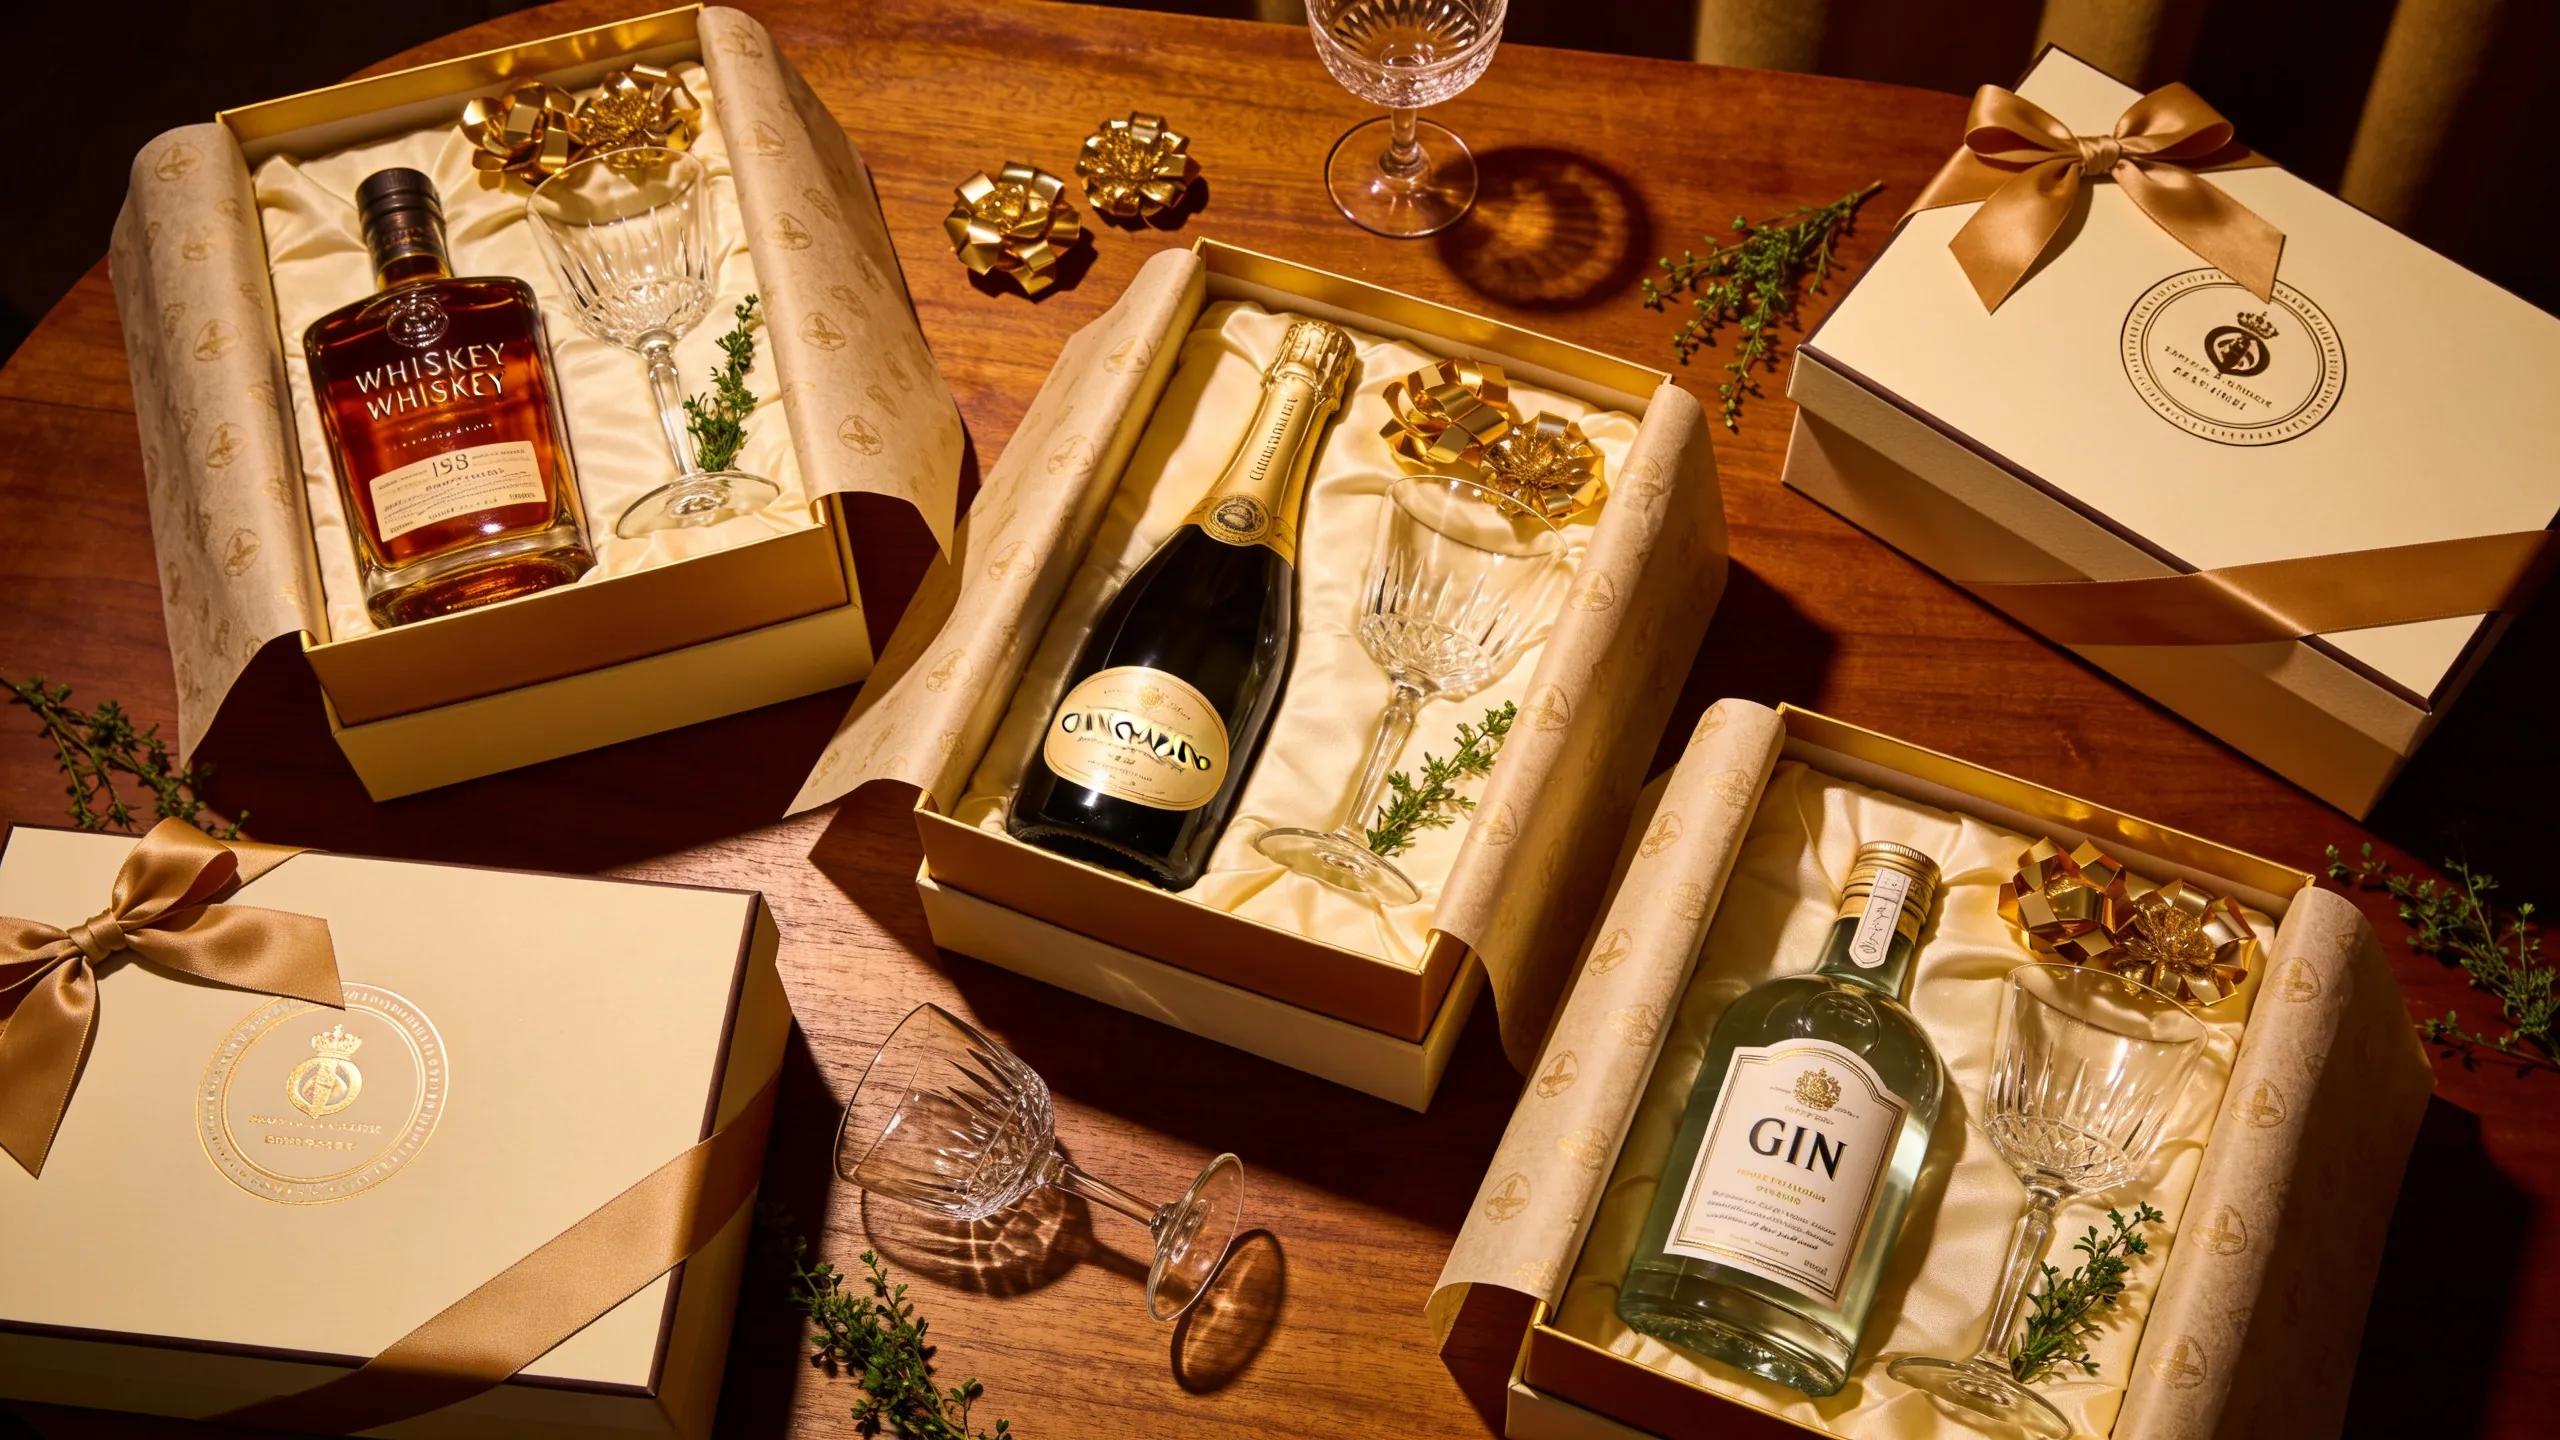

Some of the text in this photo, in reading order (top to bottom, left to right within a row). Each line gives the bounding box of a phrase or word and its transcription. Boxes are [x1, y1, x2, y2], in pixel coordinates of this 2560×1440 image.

[356, 343, 504, 393] WHISKEY
[367, 372, 503, 419] WHISKEY
[1749, 1117, 1847, 1181] GIN
